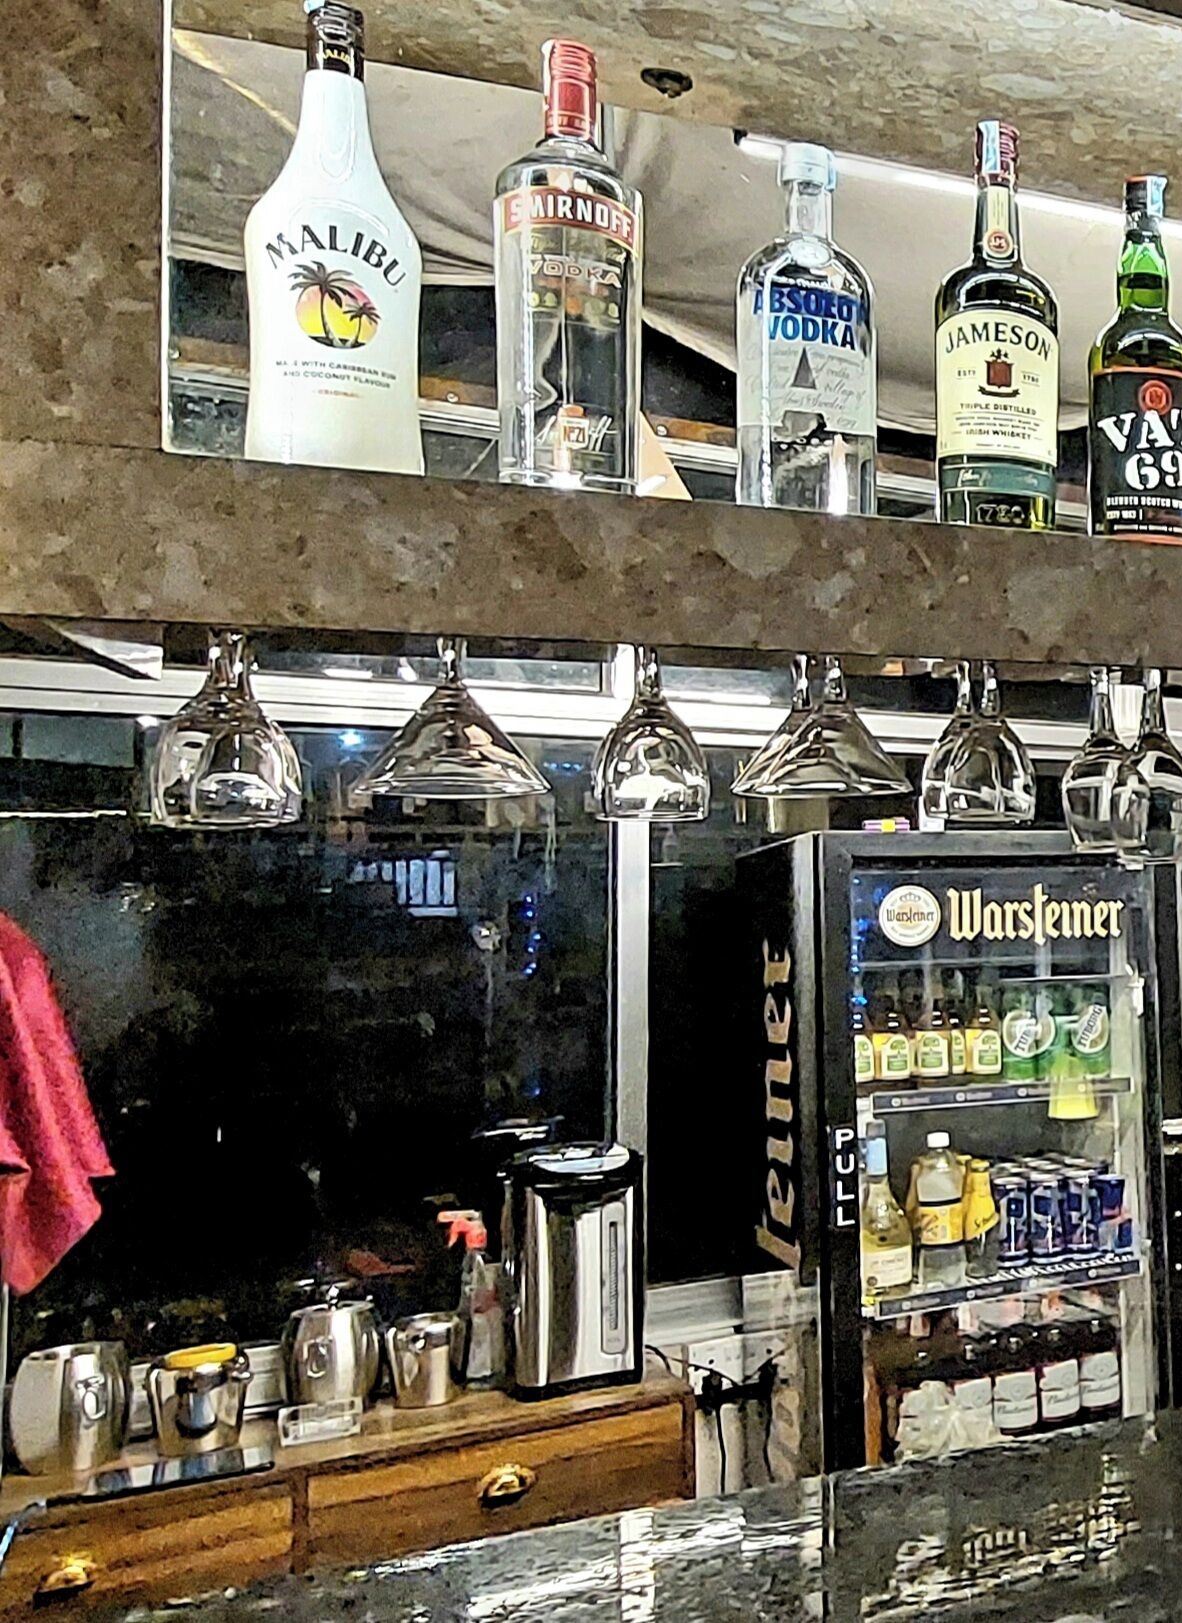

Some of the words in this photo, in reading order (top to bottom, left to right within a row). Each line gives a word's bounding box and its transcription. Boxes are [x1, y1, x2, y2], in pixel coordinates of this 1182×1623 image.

[510, 194, 632, 240] SMIRNOFF
[265, 224, 406, 288] MALIBU
[530, 260, 622, 288] VODKA
[768, 314, 856, 350] VODKA
[945, 322, 1051, 361] JAMESON
[303, 370, 351, 381] COCONUT
[960, 402, 991, 412] TRIPLE
[993, 403, 1037, 417] DISTILLED
[886, 906, 935, 930] Warsteiner
[947, 883, 1124, 946] Warsteiner
[1078, 1006, 1103, 1048] TUBORG
[834, 1128, 856, 1227] PULL
